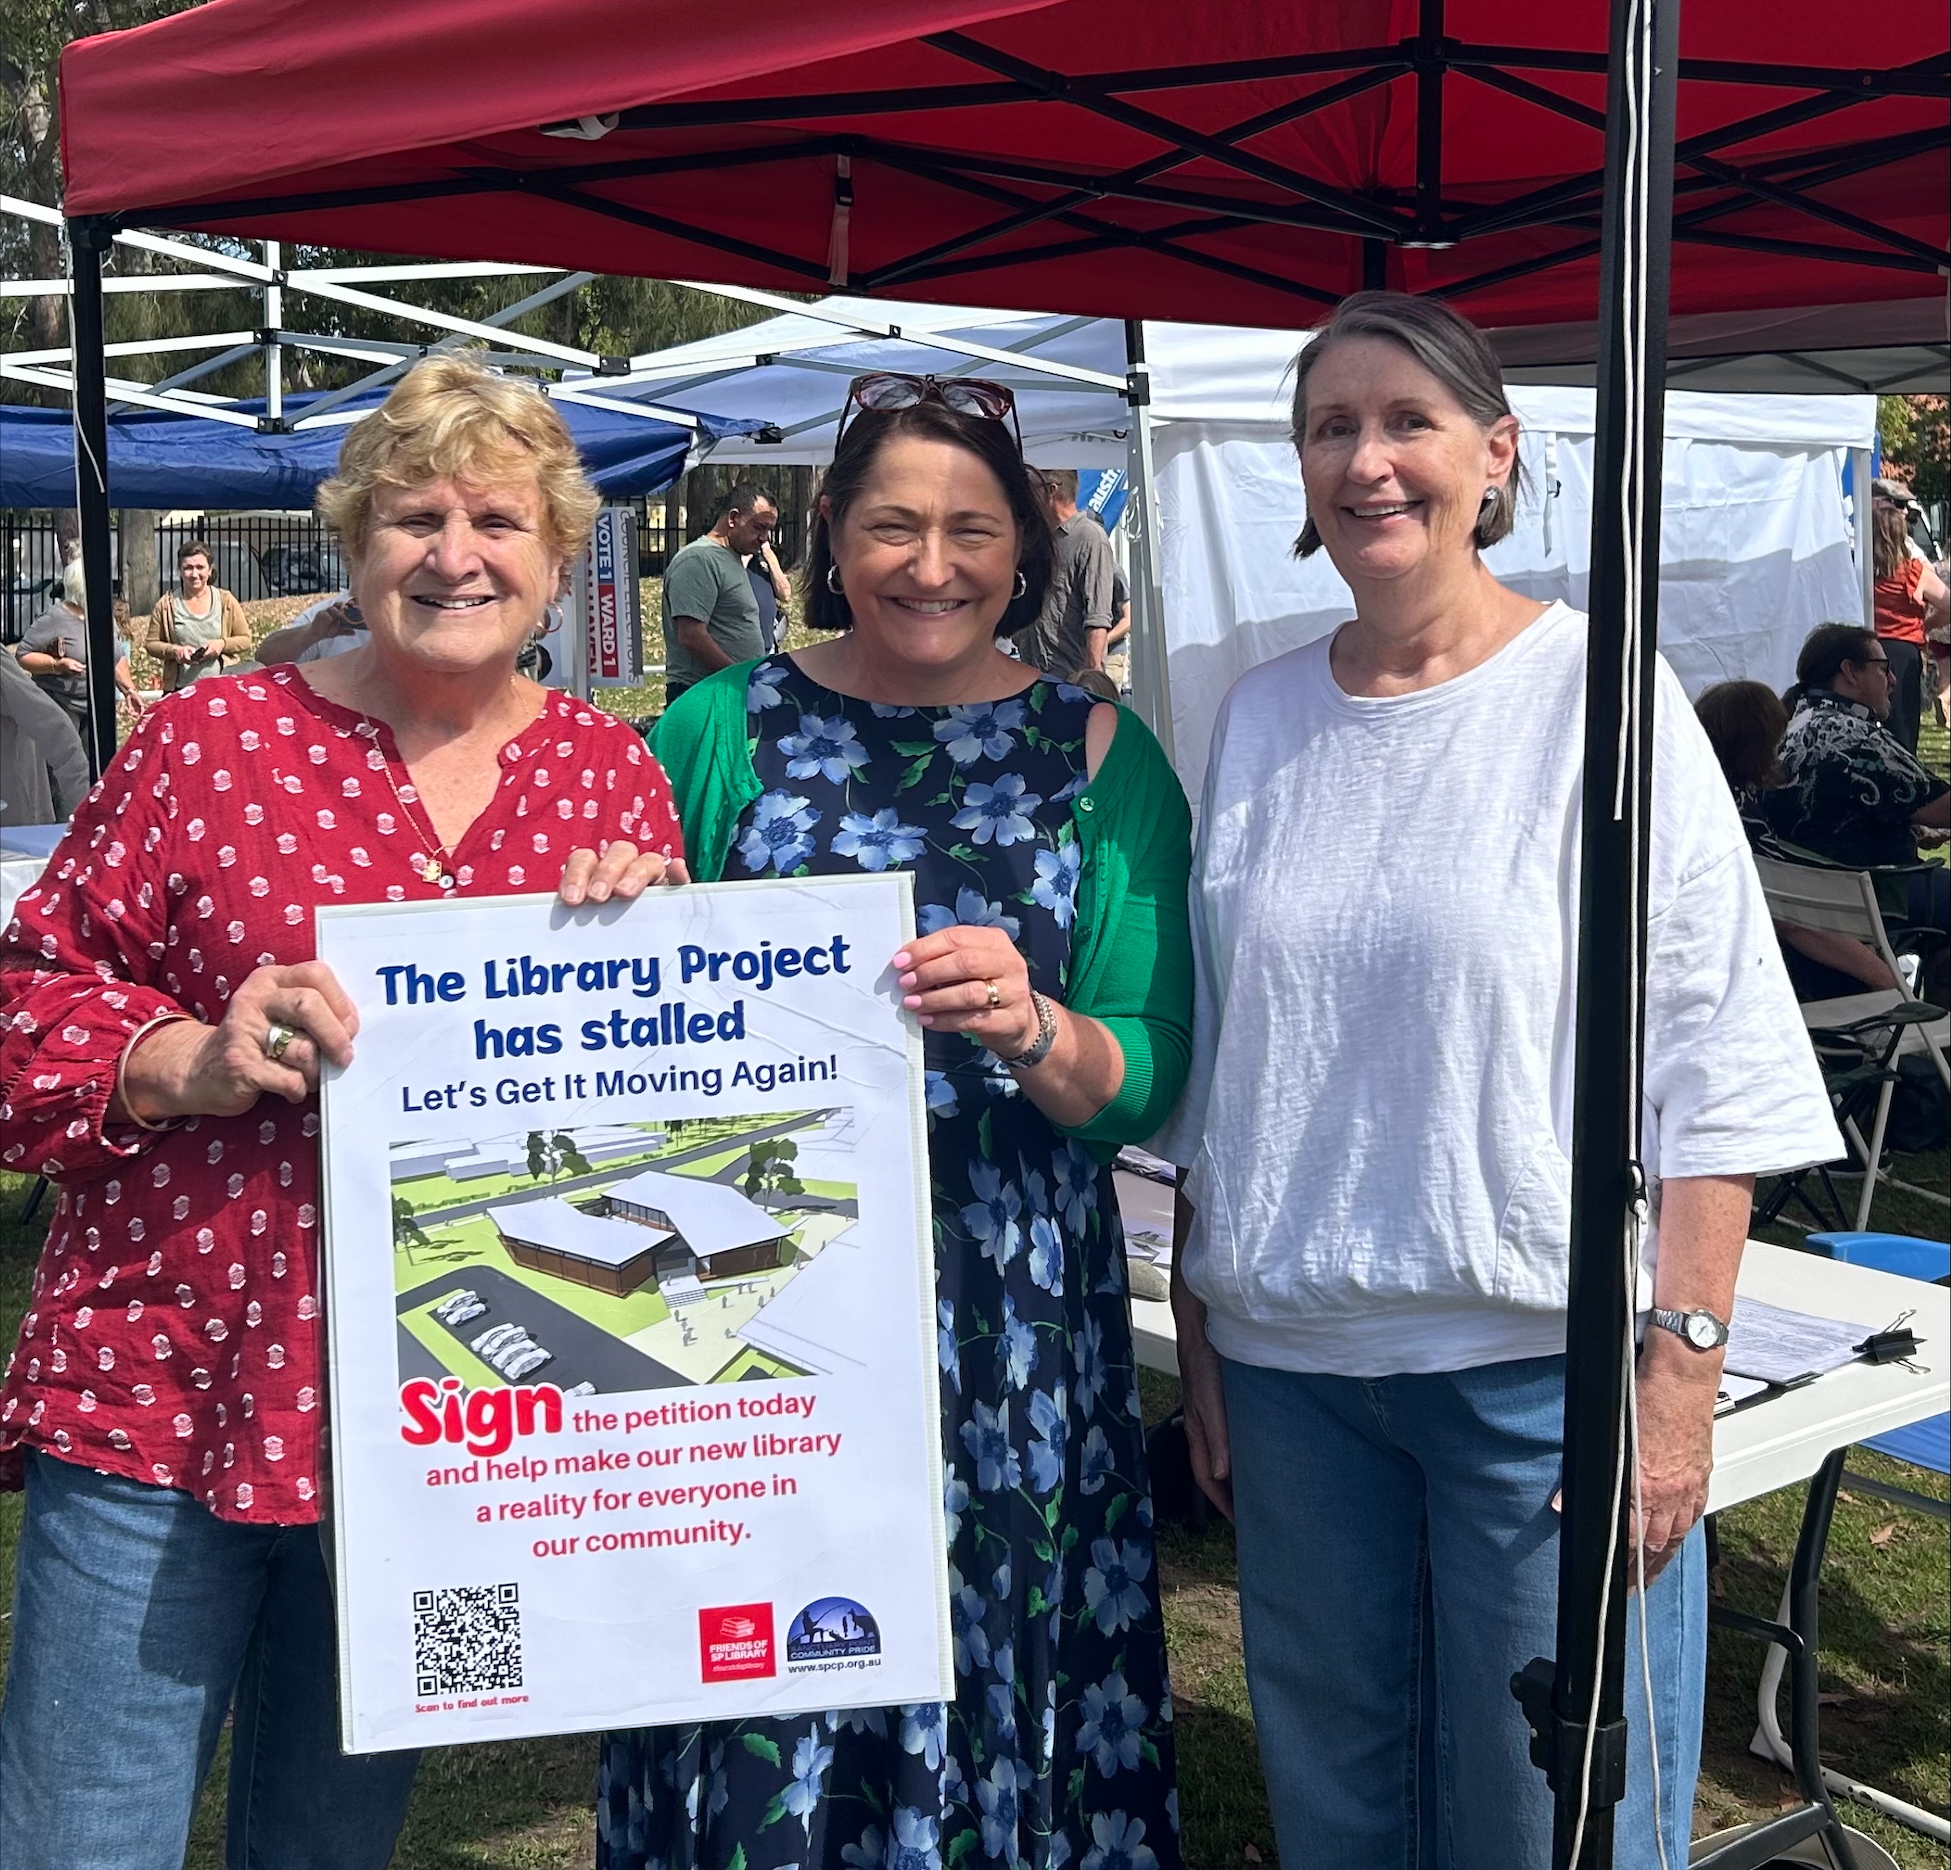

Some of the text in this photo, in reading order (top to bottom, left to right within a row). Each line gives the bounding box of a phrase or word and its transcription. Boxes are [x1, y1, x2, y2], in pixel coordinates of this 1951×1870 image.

[1088, 469, 1121, 513] austr
[598, 516, 613, 580] VOTE 1
[601, 593, 616, 666] WARD 1
[376, 935, 851, 1005] The Library Project
[474, 1000, 745, 1059] has stalled
[403, 1055, 837, 1112] Let’s Get It Moving Again!
[402, 1381, 816, 1456] Sign the petition today
[427, 1434, 841, 1486] and help make our new library
[477, 1474, 796, 1522] a reality for everyone in
[533, 1520, 751, 1557] our community.
[709, 1640, 768, 1654] FRIENDS OF
[711, 1649, 768, 1662] SP LIBRARY
[788, 1658, 881, 1674] www.spcp.org.au
[790, 1645, 876, 1660] COMMUNITY PRIDE
[415, 1694, 529, 1713] Scan to find out more
